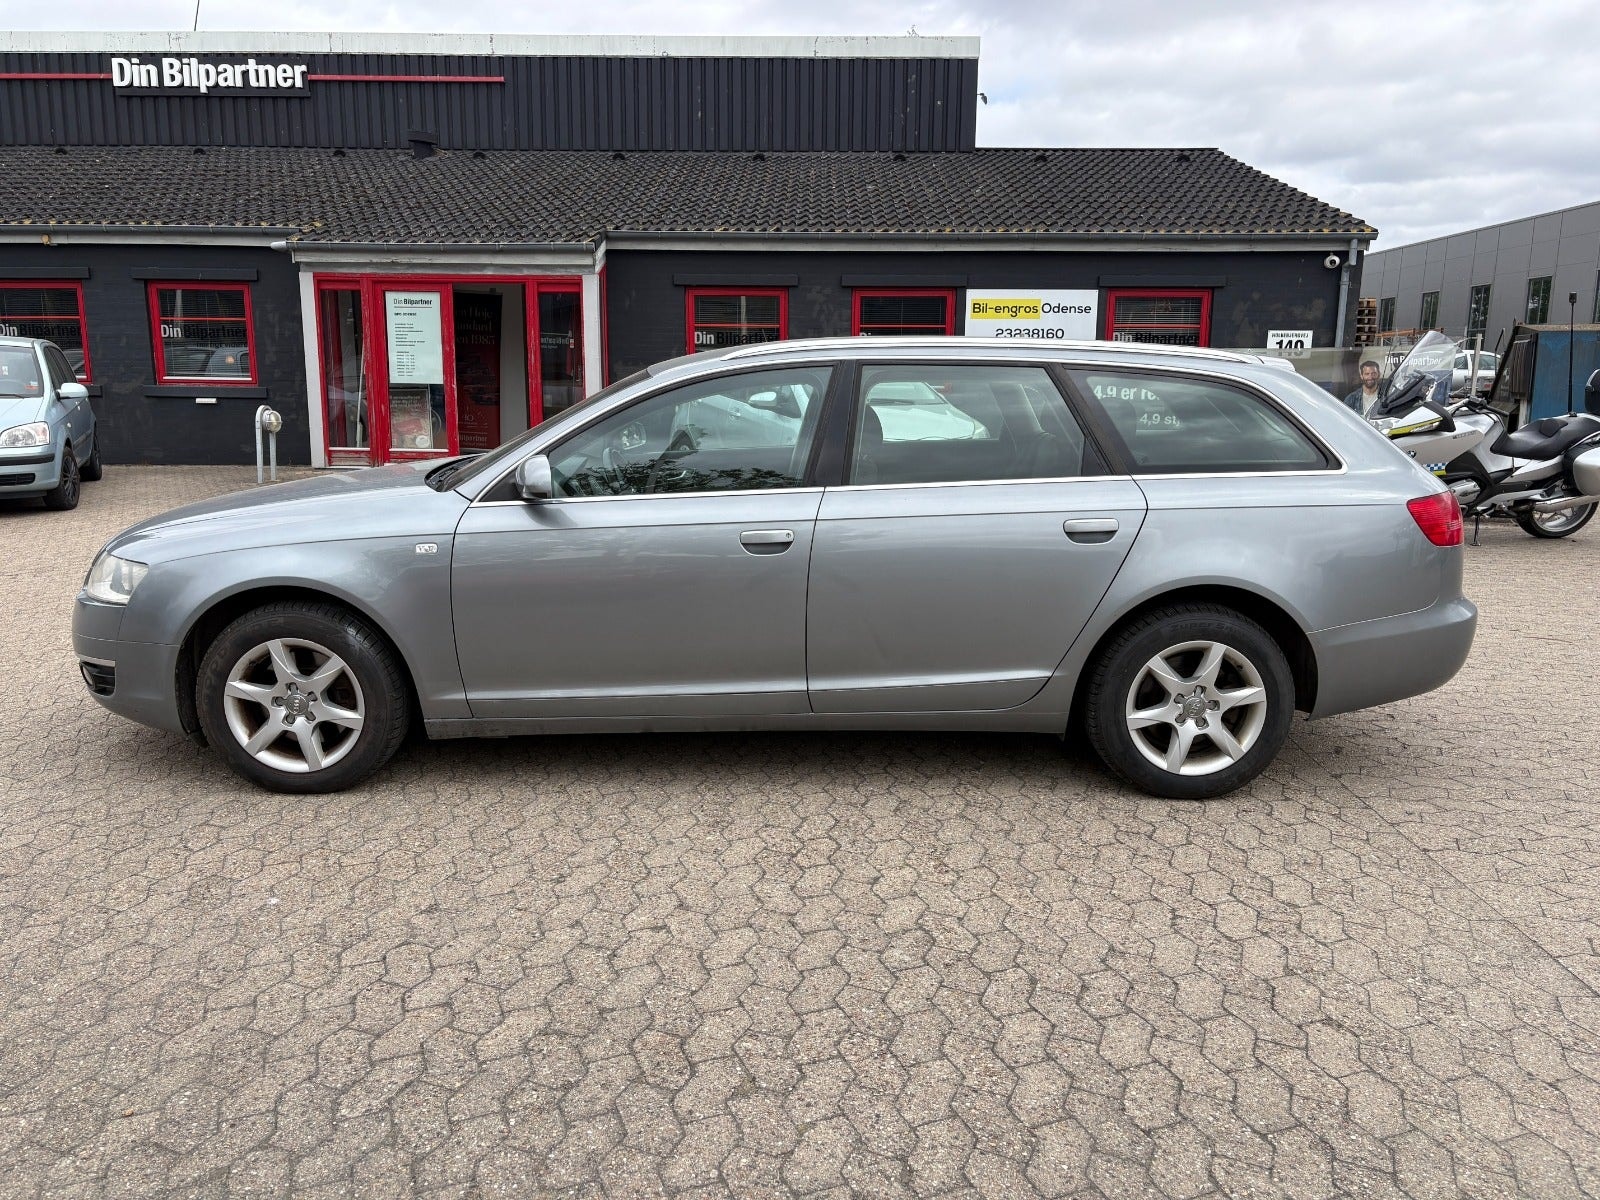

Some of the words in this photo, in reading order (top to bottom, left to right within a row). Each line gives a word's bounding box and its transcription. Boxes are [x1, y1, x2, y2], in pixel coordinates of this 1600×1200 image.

[111, 57, 159, 88] Din
[162, 57, 307, 94] Bilpartner
[403, 298, 432, 306] Bilpartner
[972, 302, 1039, 318] Bil-engros
[1041, 302, 1092, 314] Odense
[160, 324, 182, 338] Din
[694, 331, 715, 345] Din
[1275, 339, 1305, 356] 140
[1120, 387, 1137, 400] er
